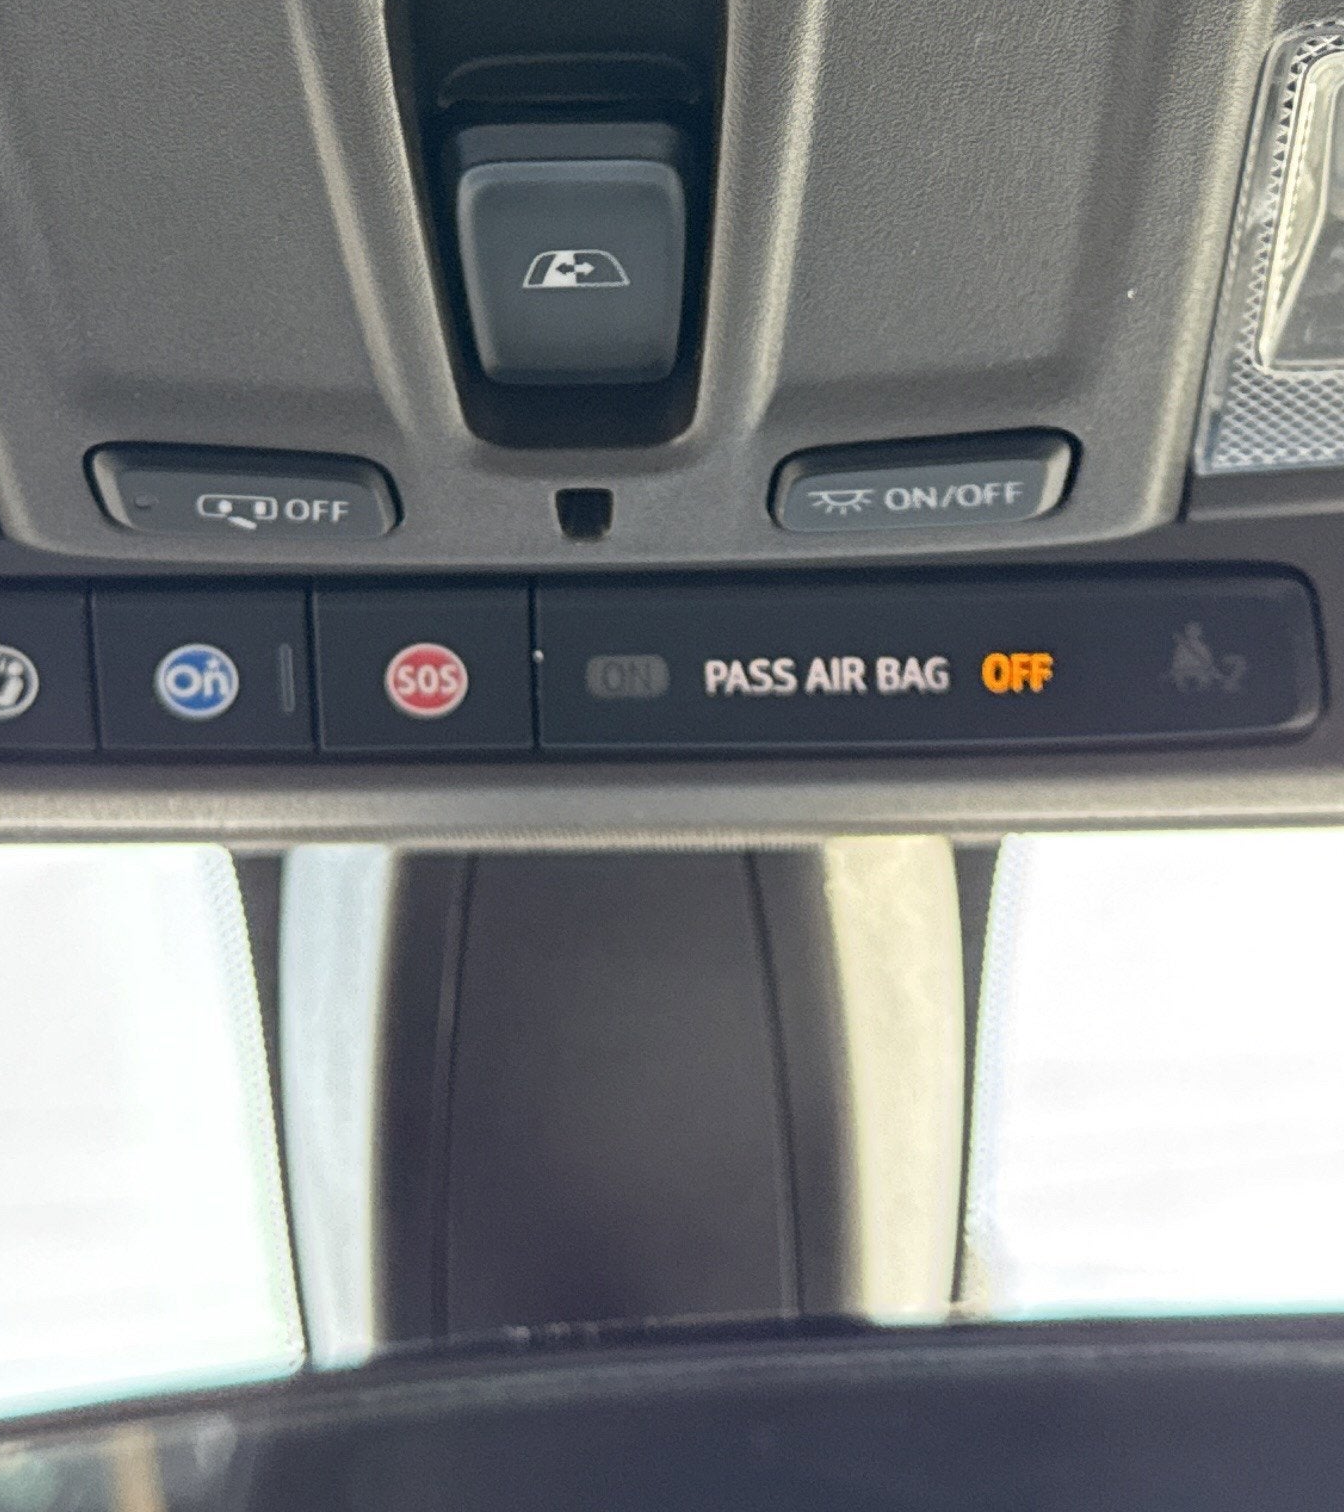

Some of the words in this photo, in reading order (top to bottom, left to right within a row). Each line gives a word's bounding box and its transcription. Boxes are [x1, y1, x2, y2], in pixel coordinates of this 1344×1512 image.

[283, 498, 350, 523] OFF
[883, 481, 1025, 512] ON/OFF
[398, 663, 458, 695] SOS
[704, 659, 798, 695] PASS
[805, 657, 865, 693] AIR
[876, 656, 951, 692] BAG
[981, 652, 1054, 694] OFF
